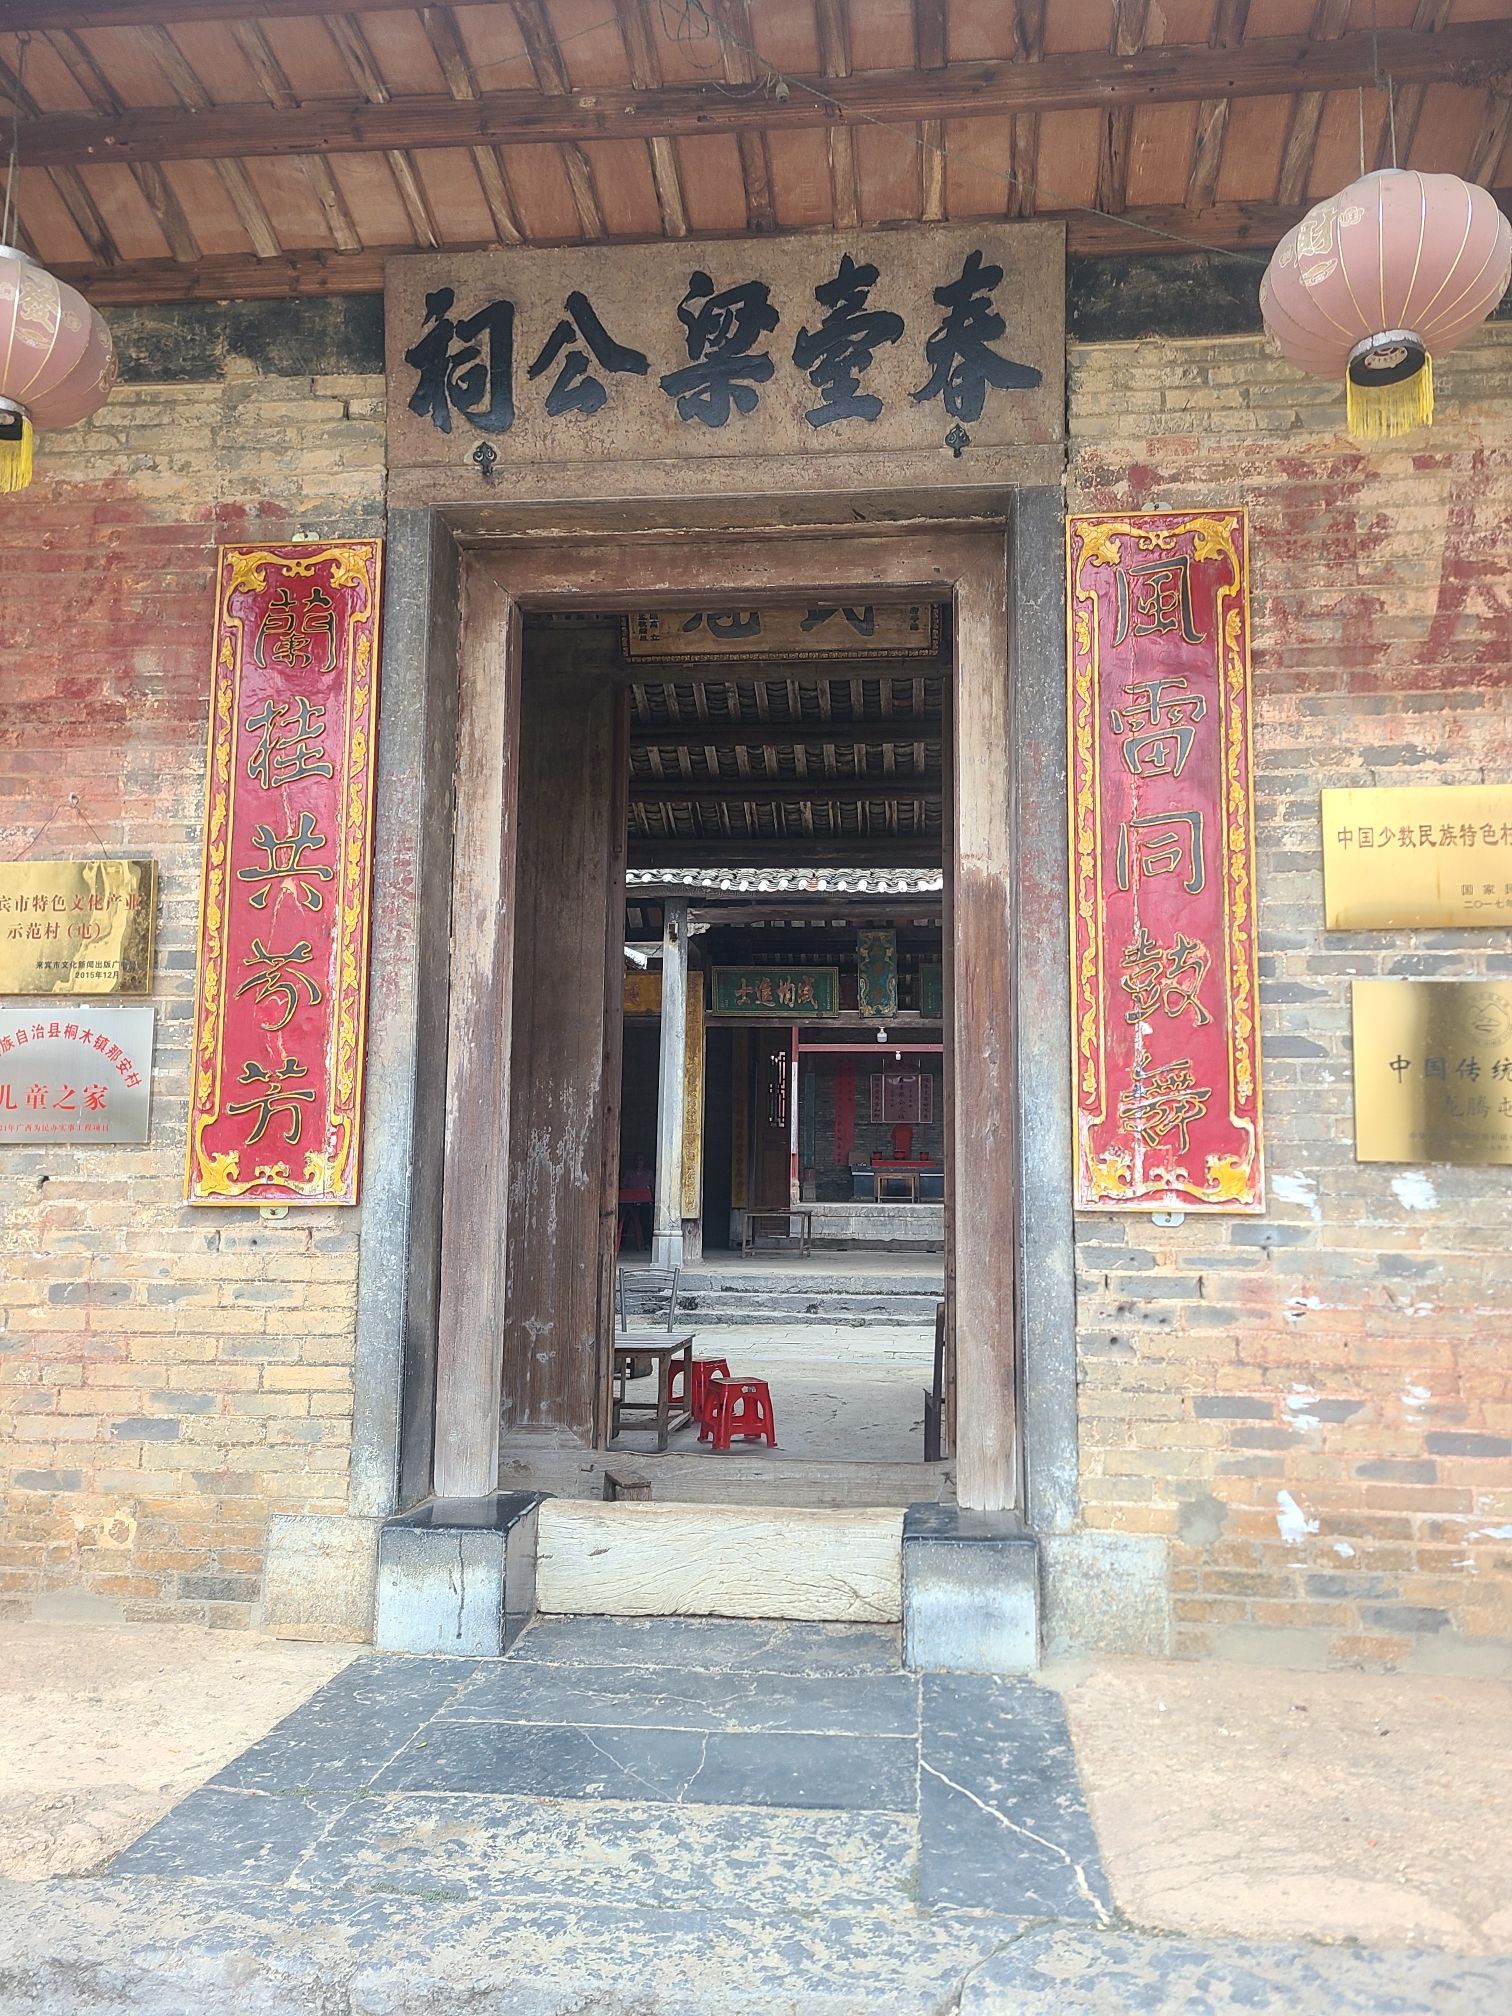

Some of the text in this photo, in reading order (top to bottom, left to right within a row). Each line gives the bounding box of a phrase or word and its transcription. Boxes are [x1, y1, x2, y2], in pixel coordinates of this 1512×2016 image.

[405, 250, 1044, 434] 春堂梁公祠
[74, 971, 119, 980] 2015年12月
